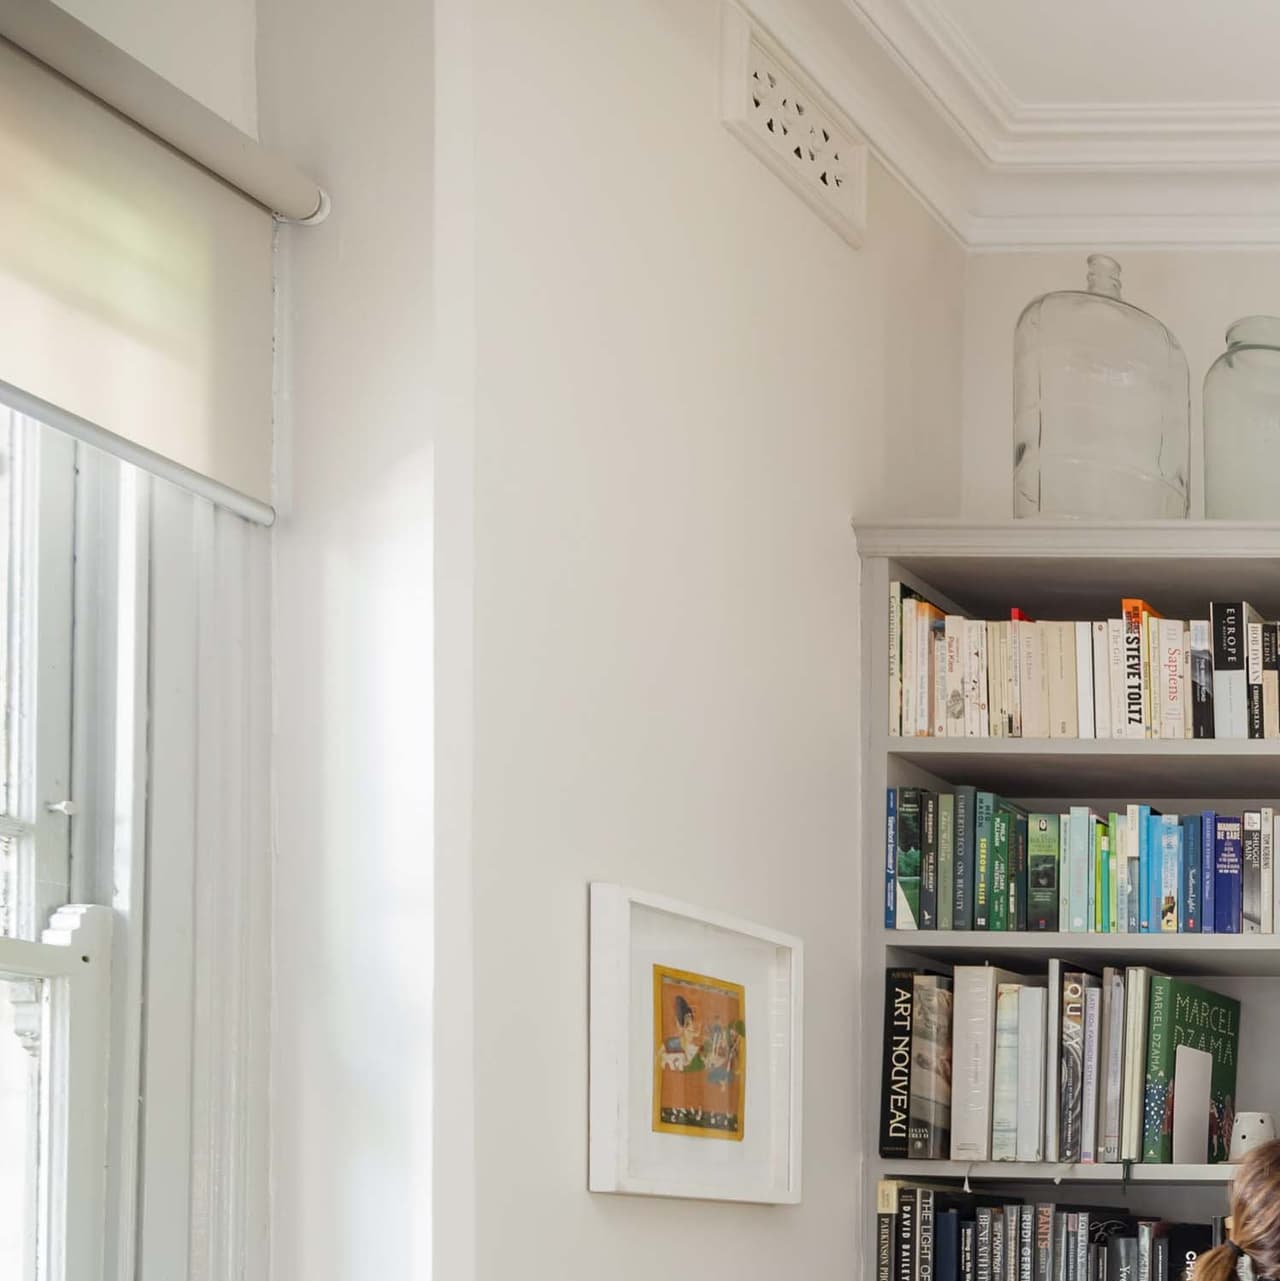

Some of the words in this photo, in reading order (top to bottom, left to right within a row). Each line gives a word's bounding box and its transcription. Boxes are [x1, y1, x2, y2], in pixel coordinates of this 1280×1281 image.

[1226, 608, 1238, 664] EUROPE
[1126, 636, 1141, 680] STEVE
[1163, 648, 1181, 702] Sapiens
[1127, 683, 1142, 726] TOLTZ
[958, 795, 966, 836] UMBERTO
[956, 861, 964, 876] ON
[979, 838, 988, 873] SORROW
[1245, 840, 1253, 861] BAIN
[1252, 832, 1261, 869] SHUGGIE
[956, 878, 965, 912] BEAUTY
[894, 987, 912, 1031] ART
[1065, 983, 1082, 1050] QUAY
[1152, 985, 1164, 1030] MARCEL
[1175, 992, 1235, 1037] MARCEL
[1150, 1033, 1162, 1072] DZAMA
[889, 1035, 910, 1139] NOUVEAU
[901, 1205, 912, 1240] DAVID
[921, 1197, 933, 1222] THE
[1021, 1213, 1031, 1244] RUDI
[1037, 1206, 1050, 1249] PANTS
[879, 1217, 890, 1266] PARKINSON
[920, 1225, 932, 1262] LIGHT
[1077, 1215, 1087, 1263] FORTUNY
[901, 1244, 911, 1281] BAILEY
